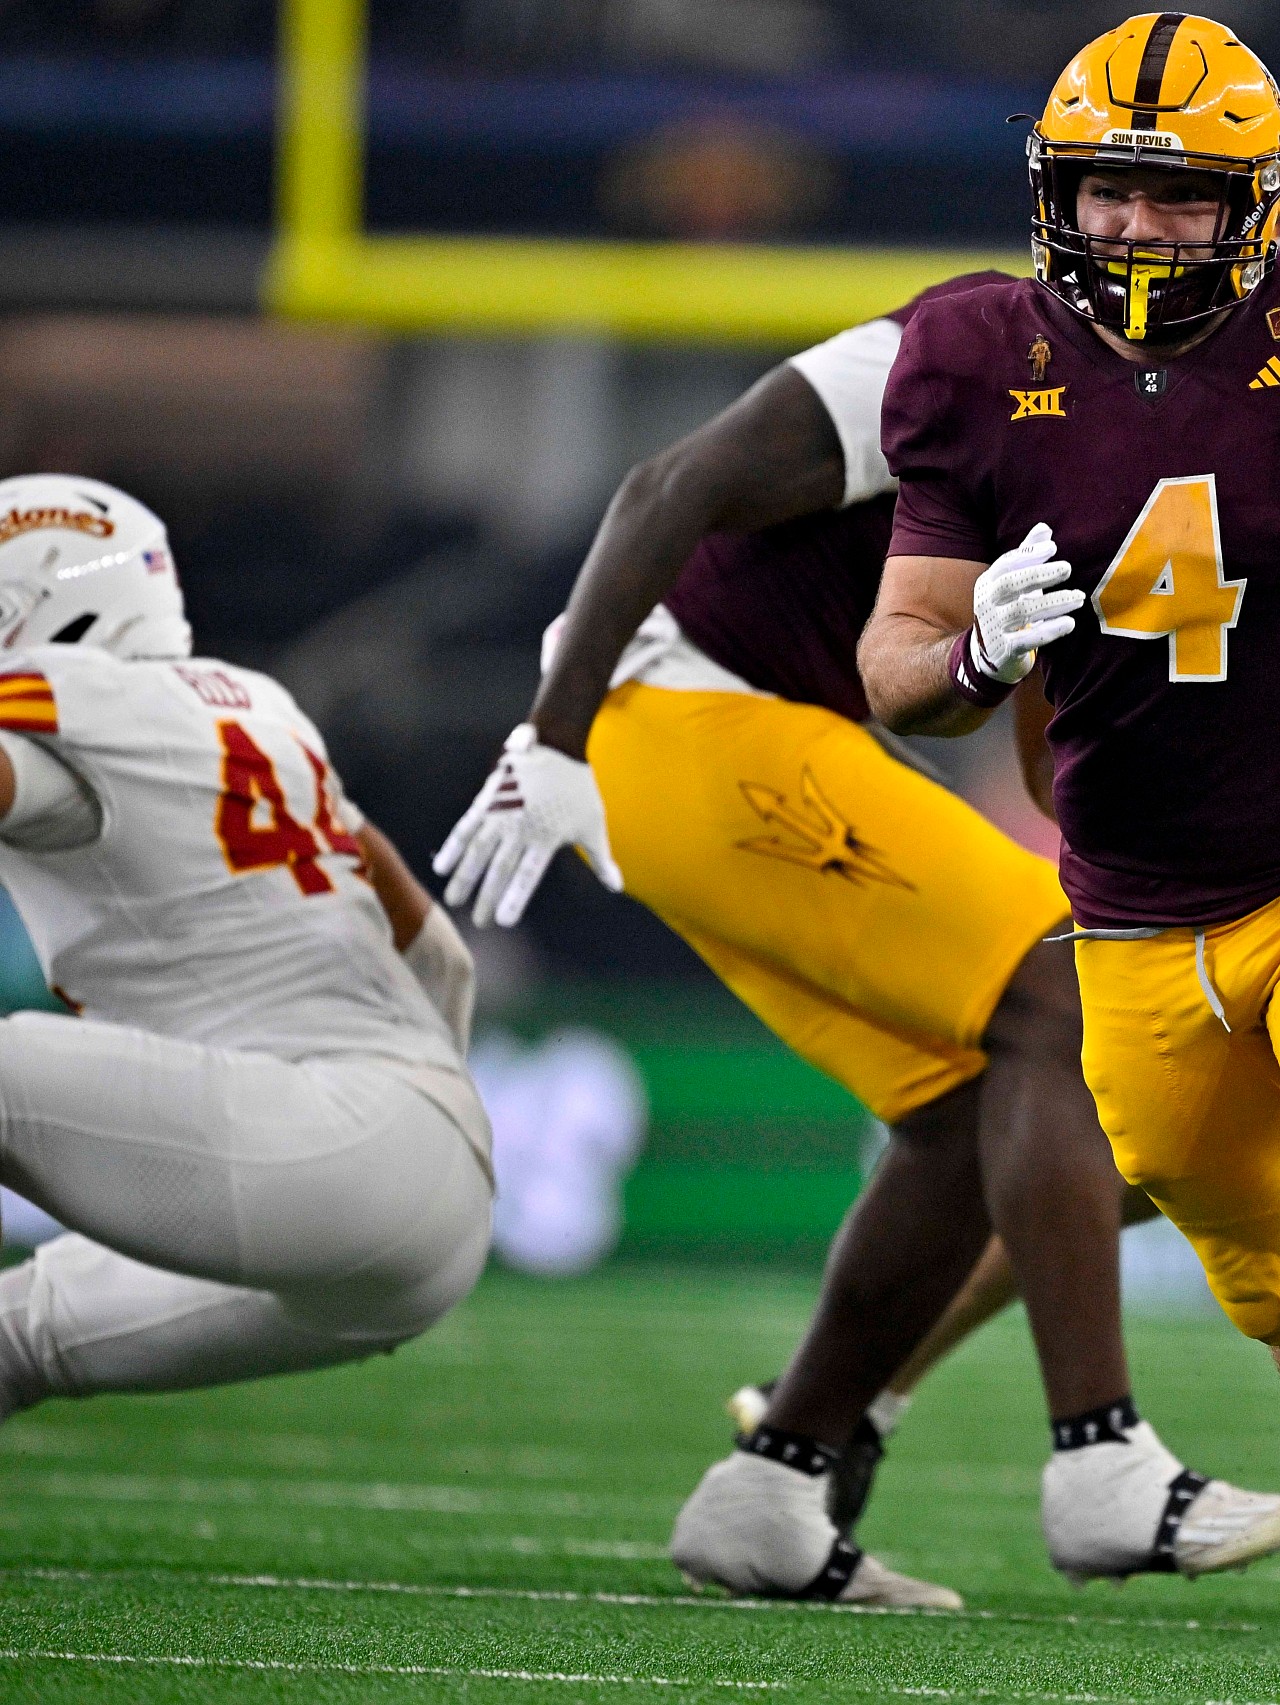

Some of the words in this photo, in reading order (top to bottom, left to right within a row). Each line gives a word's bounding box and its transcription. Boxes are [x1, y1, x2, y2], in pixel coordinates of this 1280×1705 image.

[1111, 133, 1133, 144] SUN
[1136, 135, 1172, 147] DEVILS
[1145, 372, 1158, 381] PT
[1145, 384, 1158, 393] 42
[1008, 386, 1067, 421] XII
[0, 507, 116, 544] lones
[1091, 473, 1248, 683] 4
